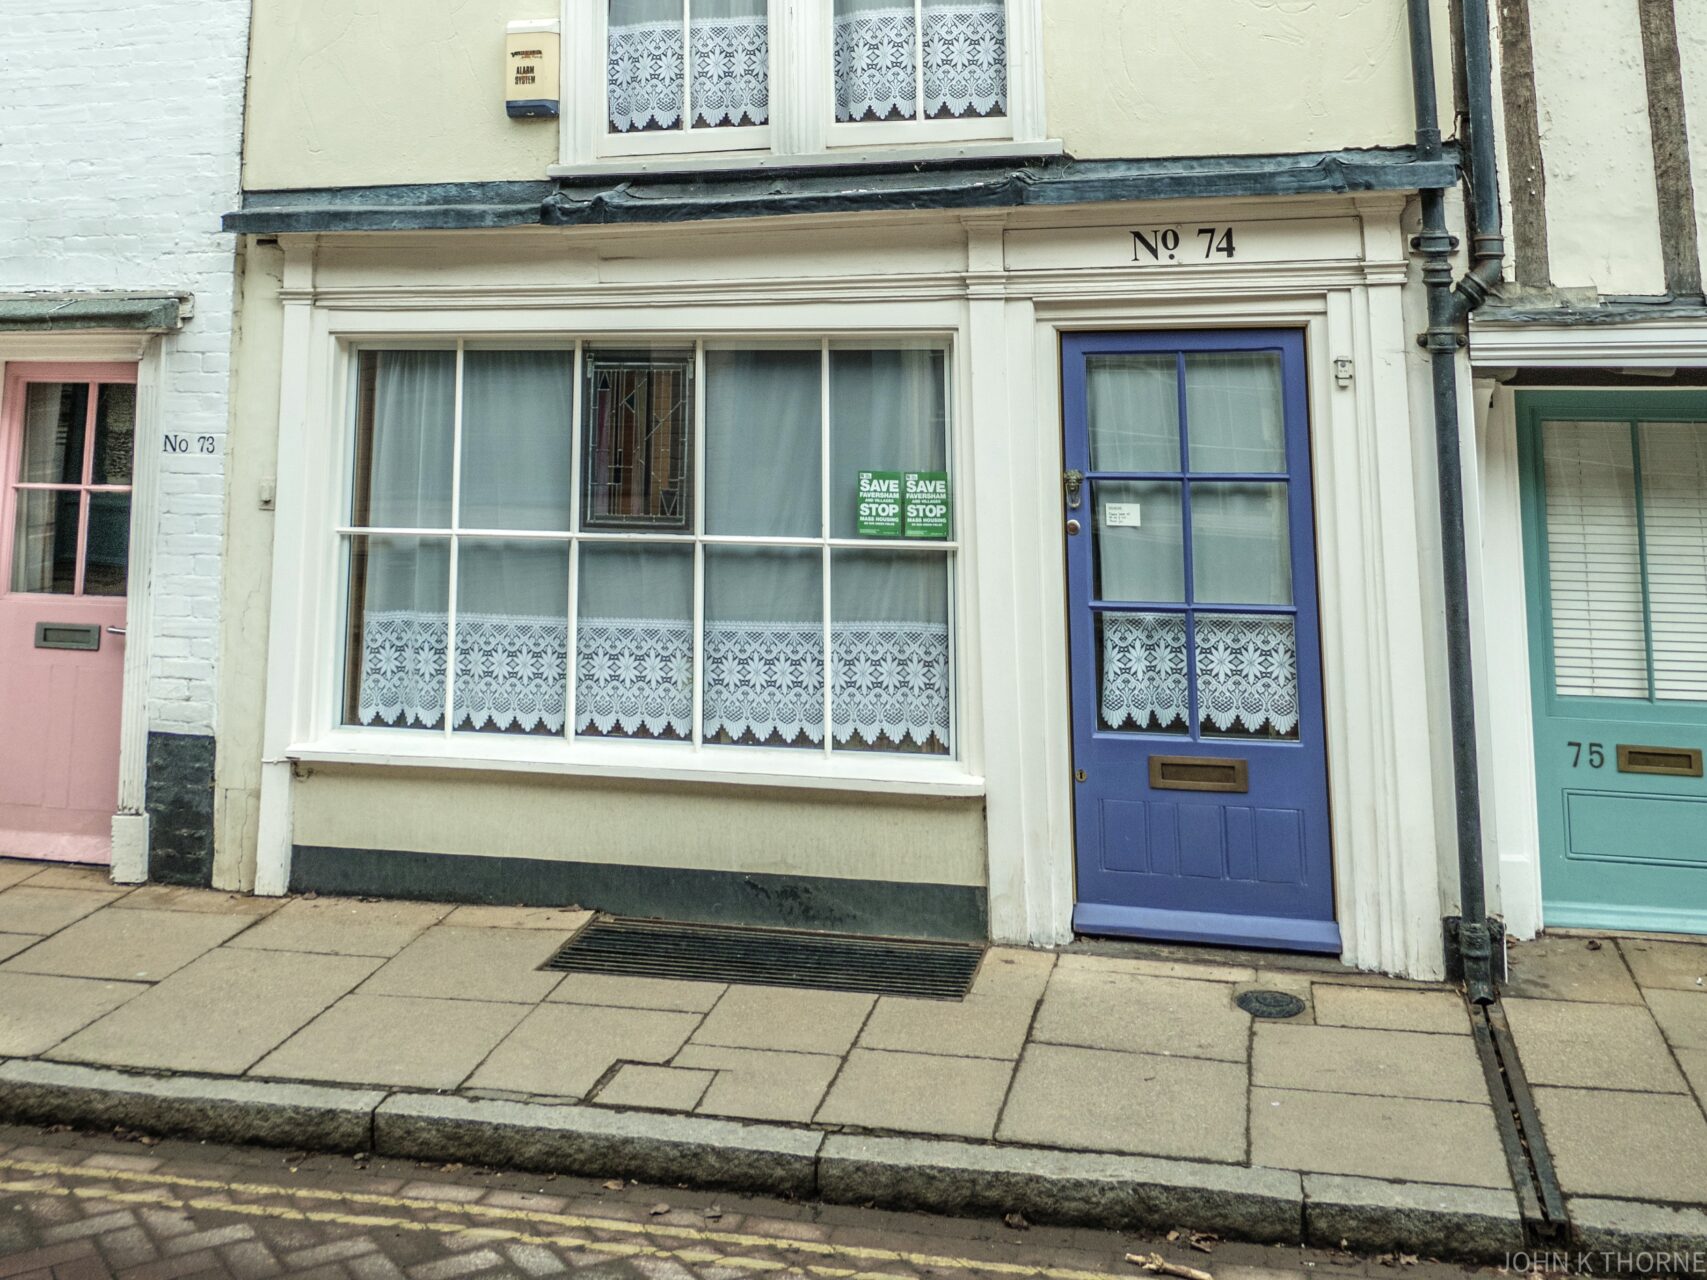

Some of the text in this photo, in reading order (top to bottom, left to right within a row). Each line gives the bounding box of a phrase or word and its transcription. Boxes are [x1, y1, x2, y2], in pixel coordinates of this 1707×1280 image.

[516, 66, 535, 75] ALARM
[515, 76, 536, 85] SYSTEM
[1197, 227, 1236, 259] 74
[162, 435, 215, 454] No 73
[860, 480, 900, 492] SAVE
[906, 481, 946, 493] SAVE
[860, 503, 900, 516] STOP
[907, 505, 947, 517] STOP
[1567, 741, 1604, 769] 75
